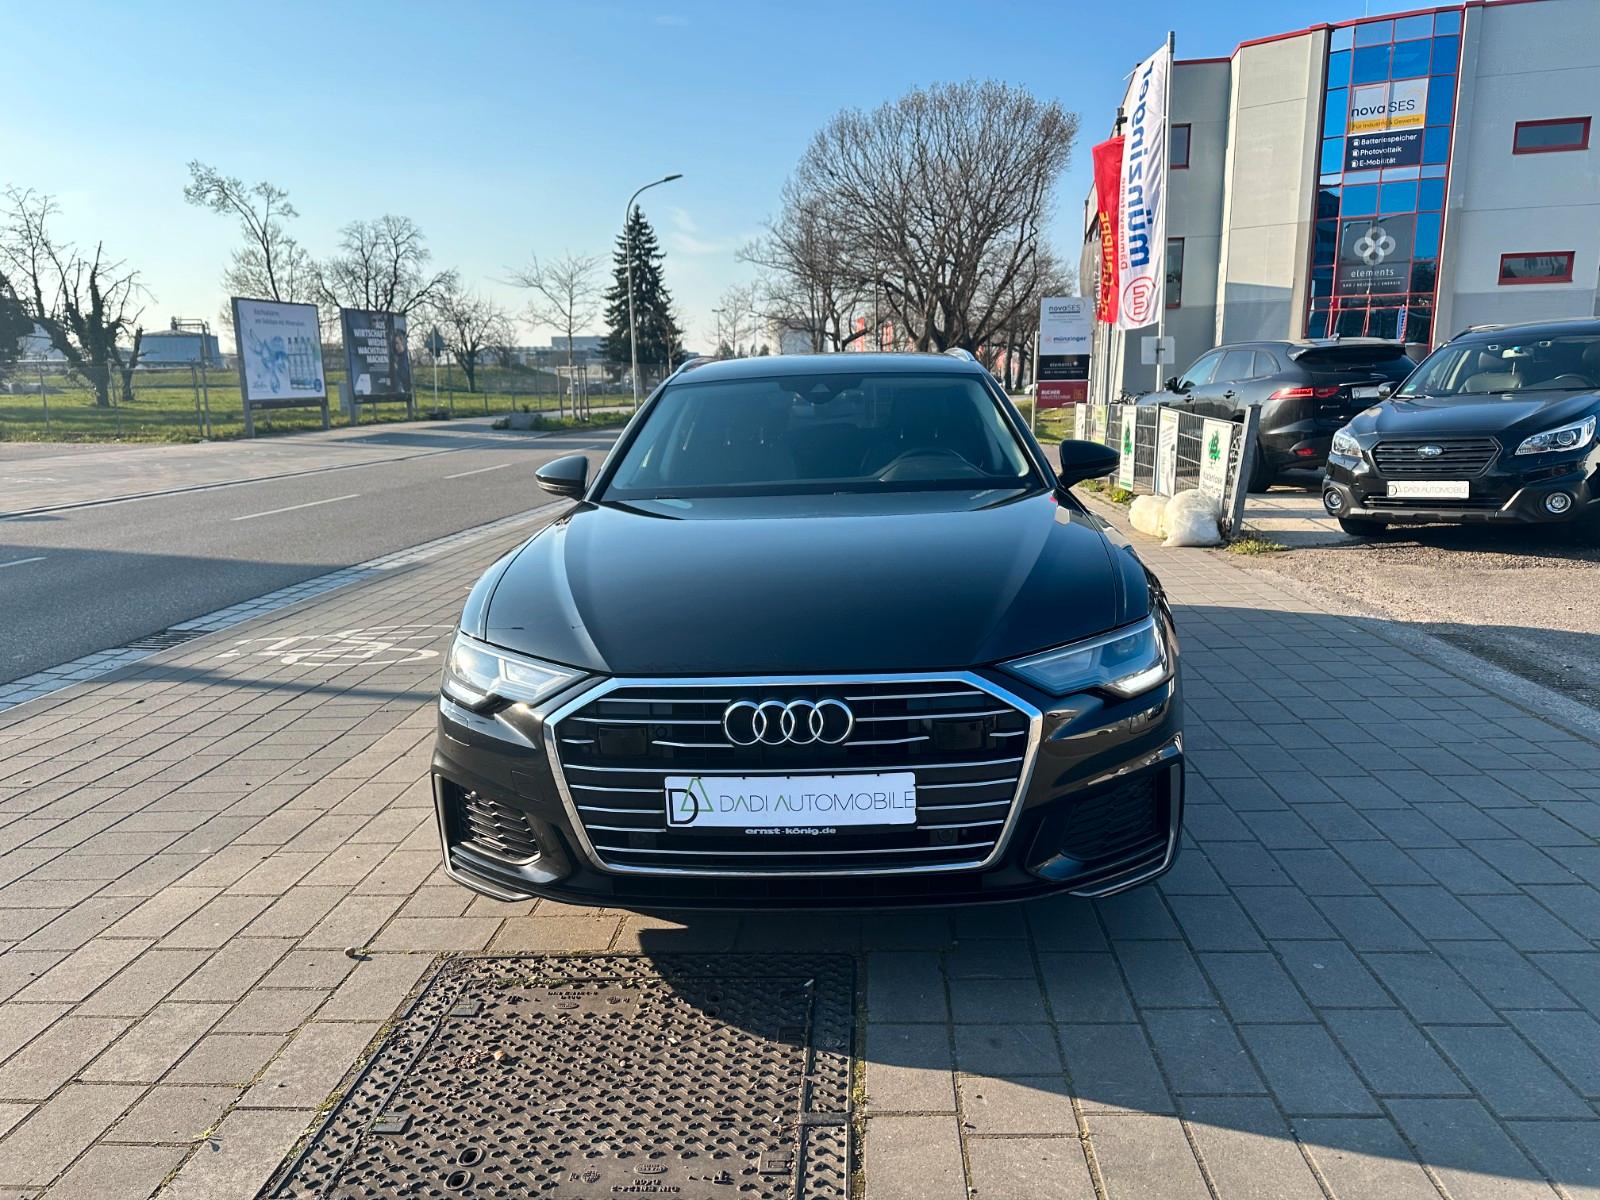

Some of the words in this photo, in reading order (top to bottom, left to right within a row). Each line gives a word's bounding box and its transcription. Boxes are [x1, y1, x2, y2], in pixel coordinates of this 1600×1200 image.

[1361, 134, 1418, 145] Batteriespeicher
[1360, 146, 1402, 156] Photovoltaik
[1359, 158, 1396, 167] E-Mobilität
[1351, 268, 1394, 278] elements
[720, 794, 769, 812] DADI
[774, 790, 916, 812] AUTOMOBILE
[745, 827, 837, 836] ernst-könig.de
